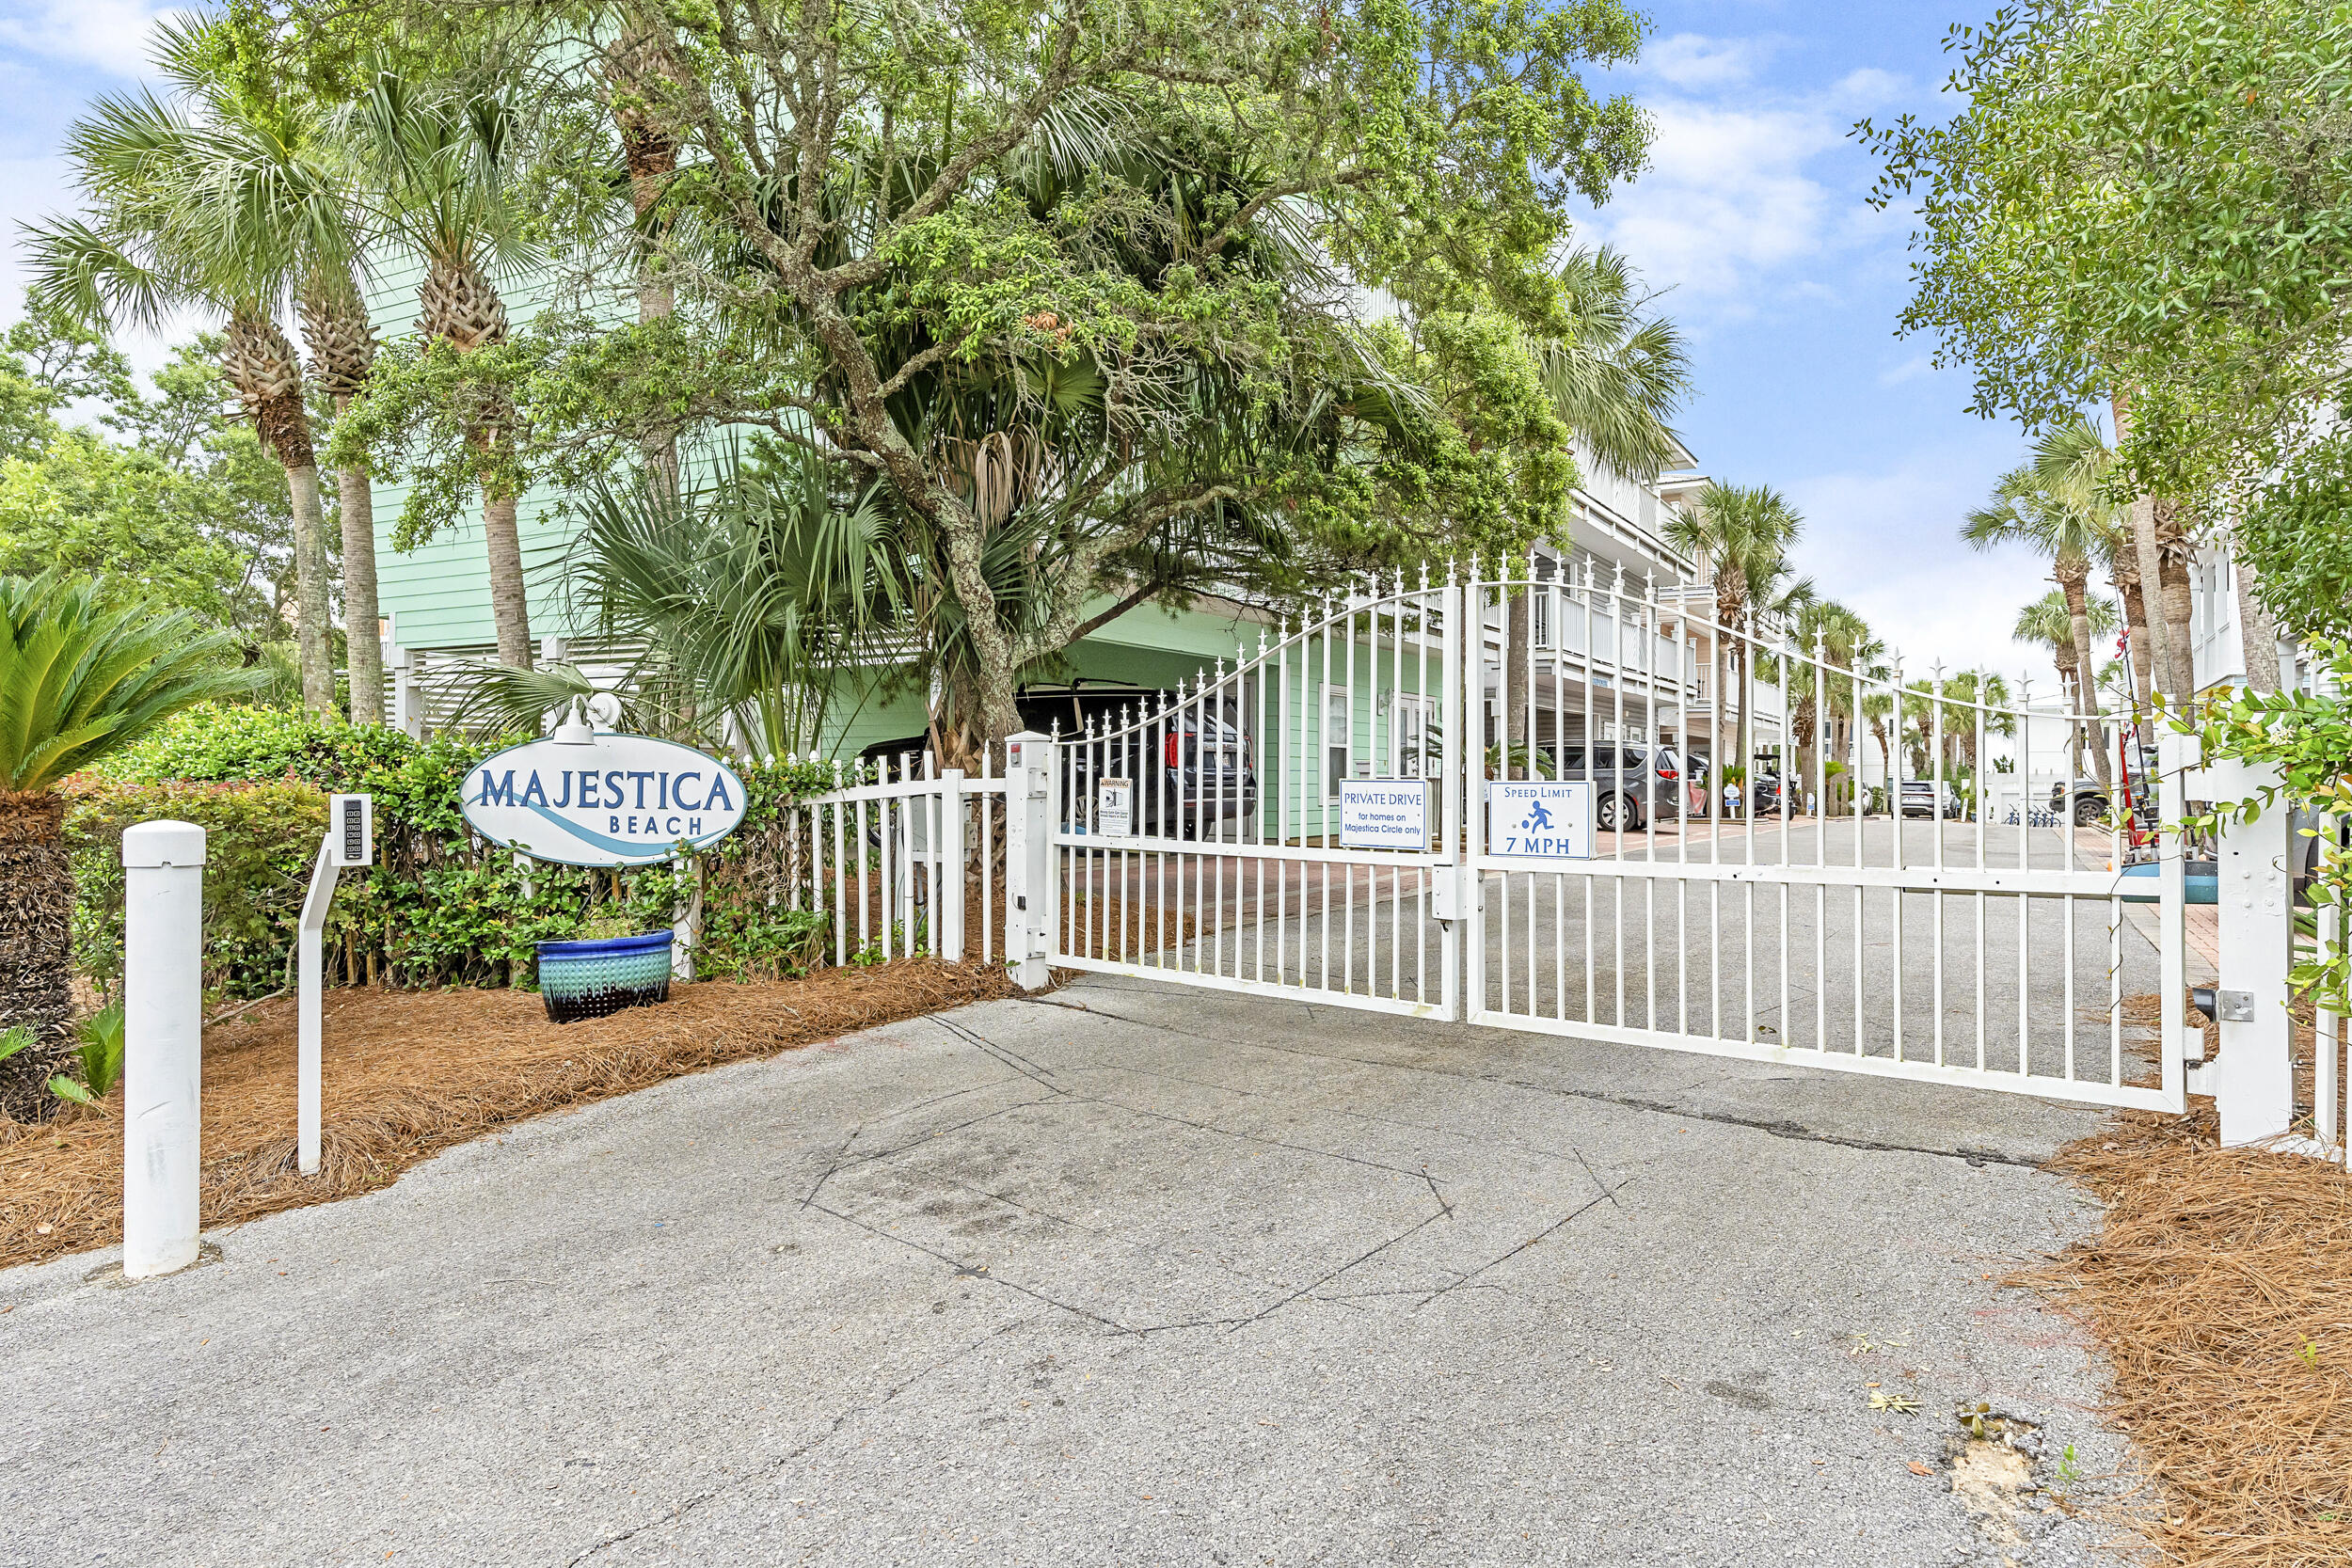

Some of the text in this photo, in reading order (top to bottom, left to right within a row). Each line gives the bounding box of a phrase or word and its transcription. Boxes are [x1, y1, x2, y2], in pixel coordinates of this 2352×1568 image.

[480, 768, 735, 812] MAJESTICA
[1504, 786, 1573, 798] SPEED LIMIT
[1344, 793, 1422, 806] PRIVATE DRIVE
[1358, 812, 1368, 820] for
[1369, 813, 1394, 821] homes
[609, 816, 702, 835] BEACH
[1344, 823, 1422, 835] Majestica Circle only
[1506, 837, 1570, 854] 7 MPH
